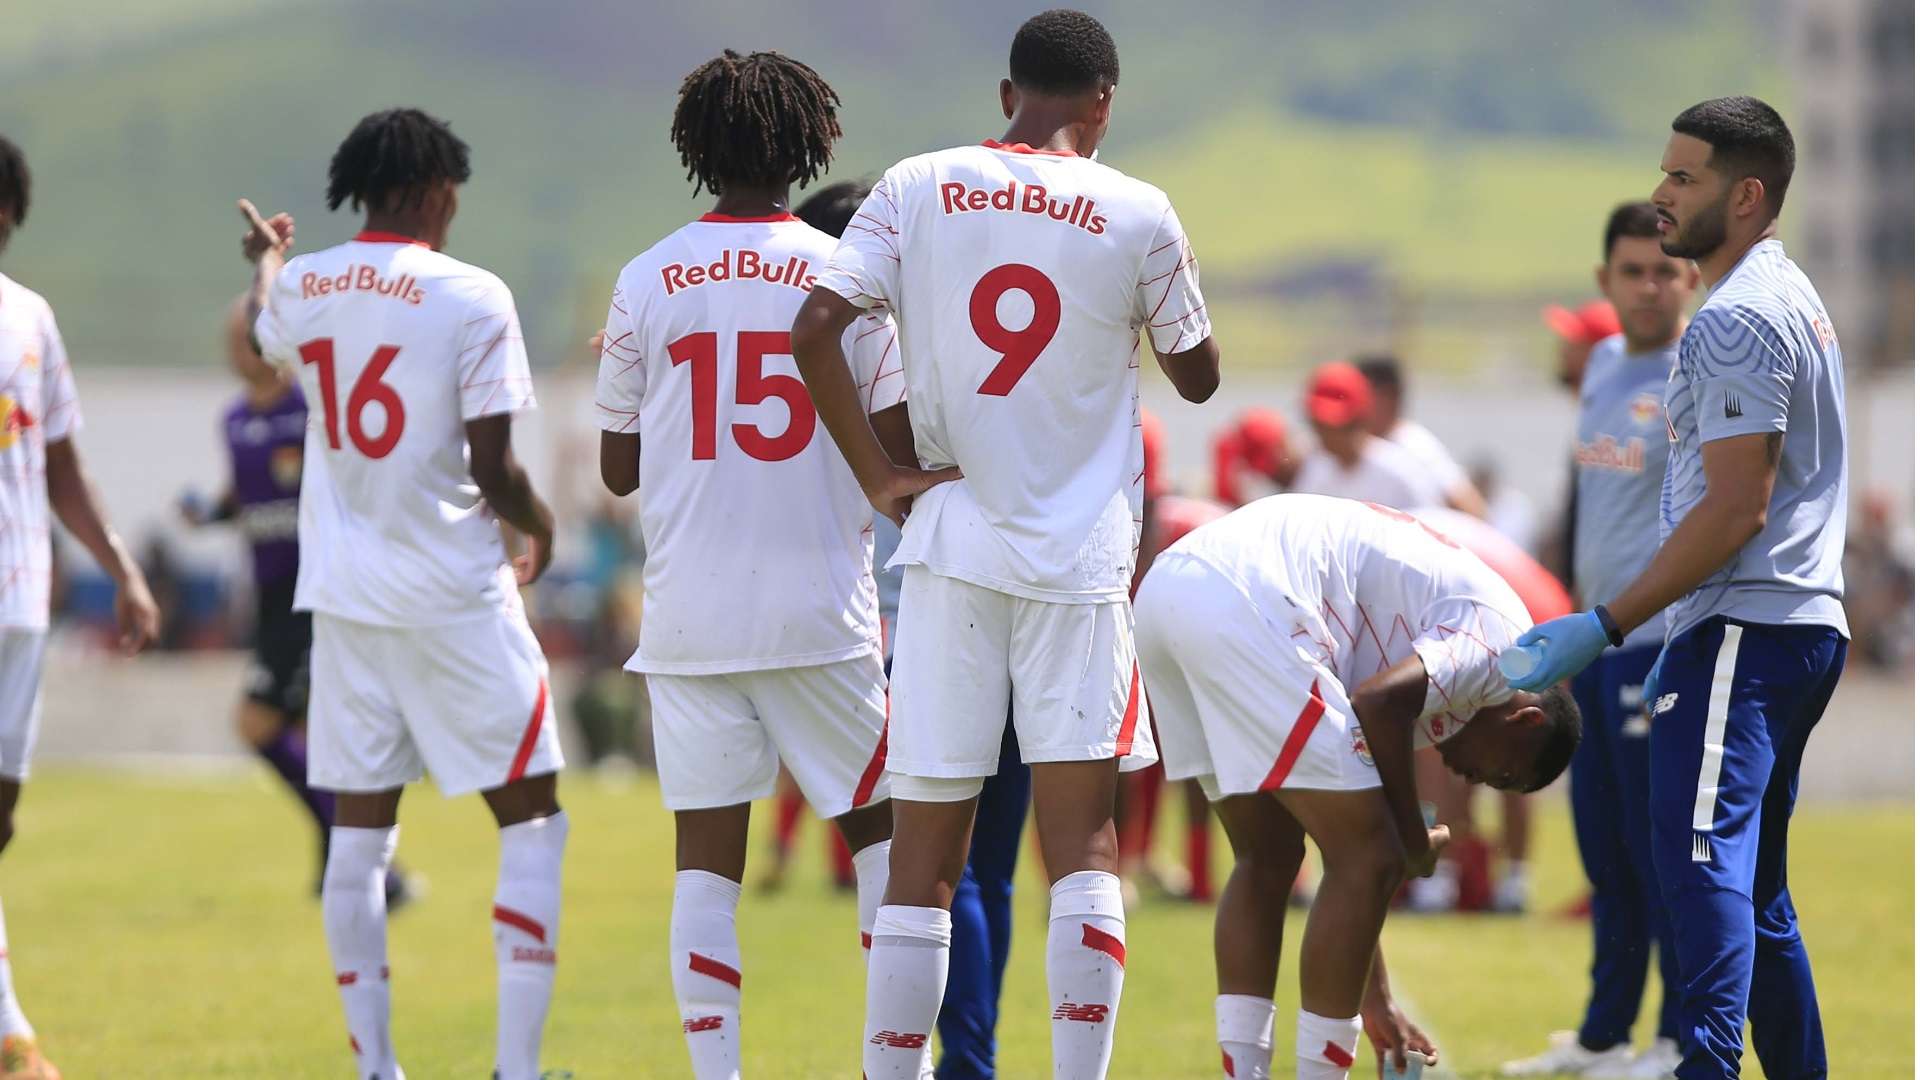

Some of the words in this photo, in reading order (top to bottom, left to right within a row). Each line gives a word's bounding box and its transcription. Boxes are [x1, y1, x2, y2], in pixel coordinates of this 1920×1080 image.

[940, 179, 1017, 215] Red
[1021, 184, 1108, 235] Bulls
[301, 263, 353, 299] Red
[356, 264, 425, 305] Bulls
[661, 249, 731, 295] Red
[736, 250, 818, 293] Bulls
[969, 263, 1061, 397] 9
[298, 337, 406, 460] 16
[667, 331, 816, 462] 15
